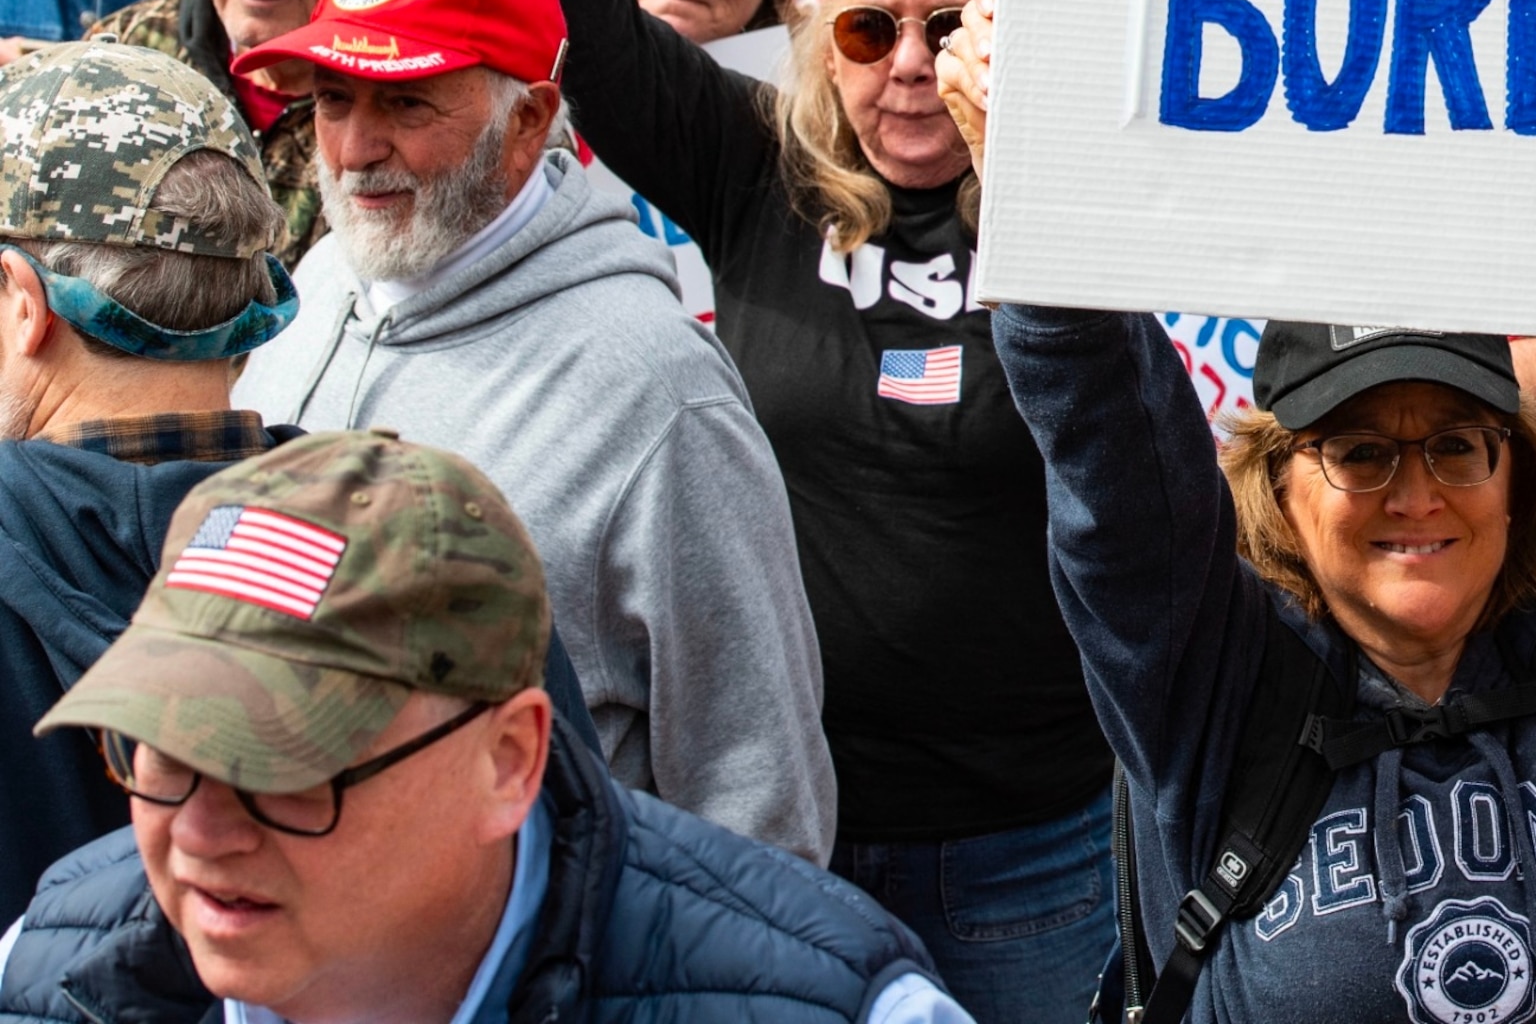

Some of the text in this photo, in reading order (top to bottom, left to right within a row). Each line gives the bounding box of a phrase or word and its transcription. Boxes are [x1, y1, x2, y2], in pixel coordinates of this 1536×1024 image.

[357, 52, 446, 73] PRESIDENT
[1423, 922, 1521, 972] ESTABLISHED
[1452, 1007, 1500, 1024] 1902
